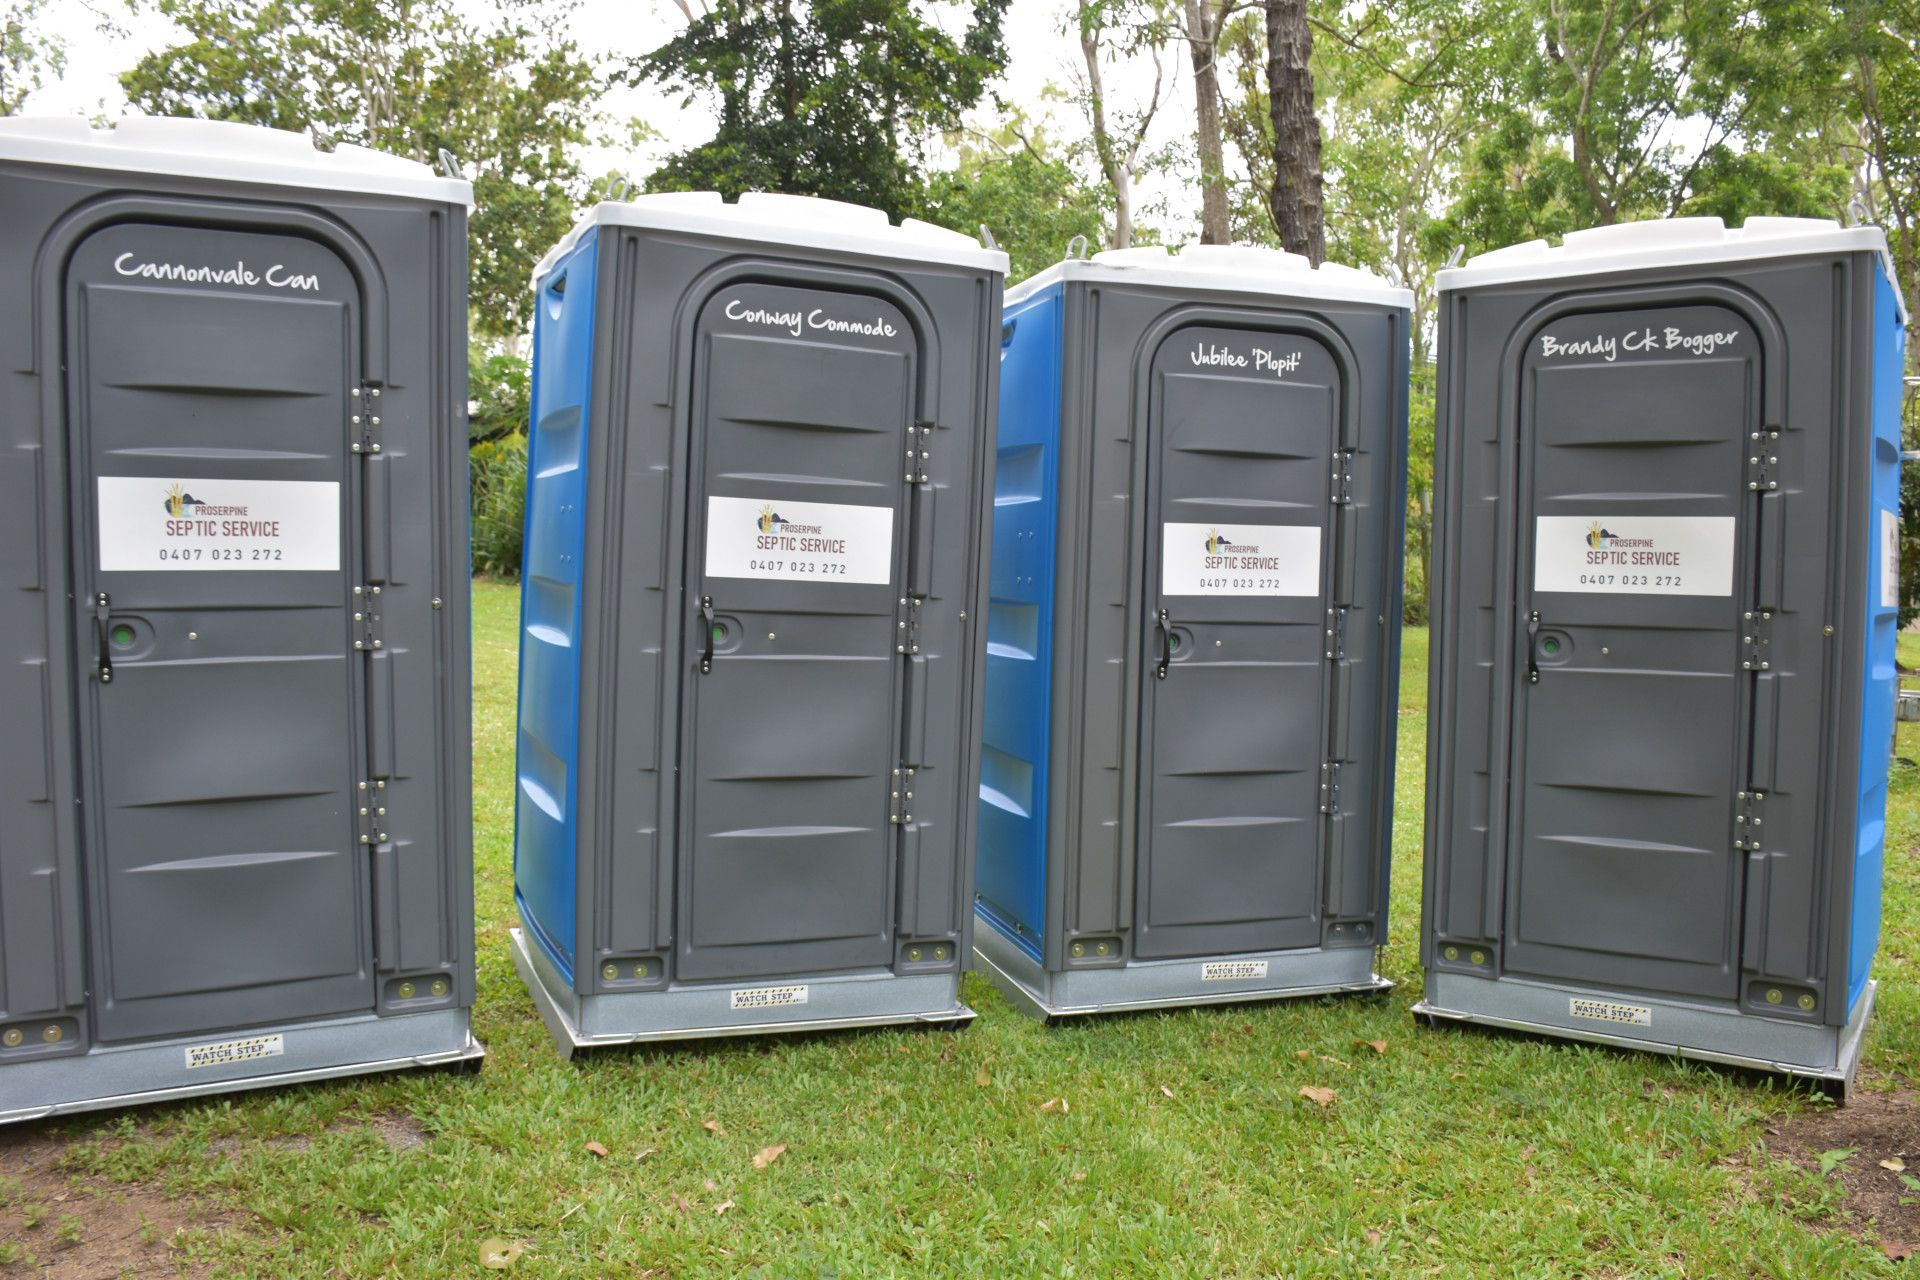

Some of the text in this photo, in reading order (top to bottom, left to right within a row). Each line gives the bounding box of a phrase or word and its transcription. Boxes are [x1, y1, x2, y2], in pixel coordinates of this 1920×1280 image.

[113, 252, 320, 292] Cannonvale Can
[725, 300, 898, 338] Conway Commode
[1541, 327, 1739, 363] Brandy Ck Bogger
[1190, 342, 1302, 377] Jubilee 'Plopit'
[195, 505, 249, 517] PROSERPINE
[166, 520, 281, 538] SEPTIC SERVICE
[780, 523, 822, 535] PROSERPINE
[756, 536, 846, 554] SEPTIC SERVICE
[1224, 545, 1260, 554] PROSERPINE
[1609, 539, 1654, 548] PROSERPINE
[159, 549, 283, 561] 0407 023 272
[1586, 551, 1681, 566] SEPTIC SERVICE
[749, 560, 847, 575] 0407 023 272
[1204, 556, 1280, 570] SEPTIC SERVICE
[1199, 578, 1280, 589] 0407 023 272
[1580, 575, 1682, 587] 0407 023 272
[1206, 967, 1234, 976] WATCH
[1236, 967, 1255, 975] STEP
[736, 994, 768, 1004] WATCH
[771, 992, 794, 1001] STEP
[1575, 1004, 1635, 1019] WATCH STEP
[191, 1048, 233, 1062] WATCH
[236, 1044, 265, 1056] STEP
